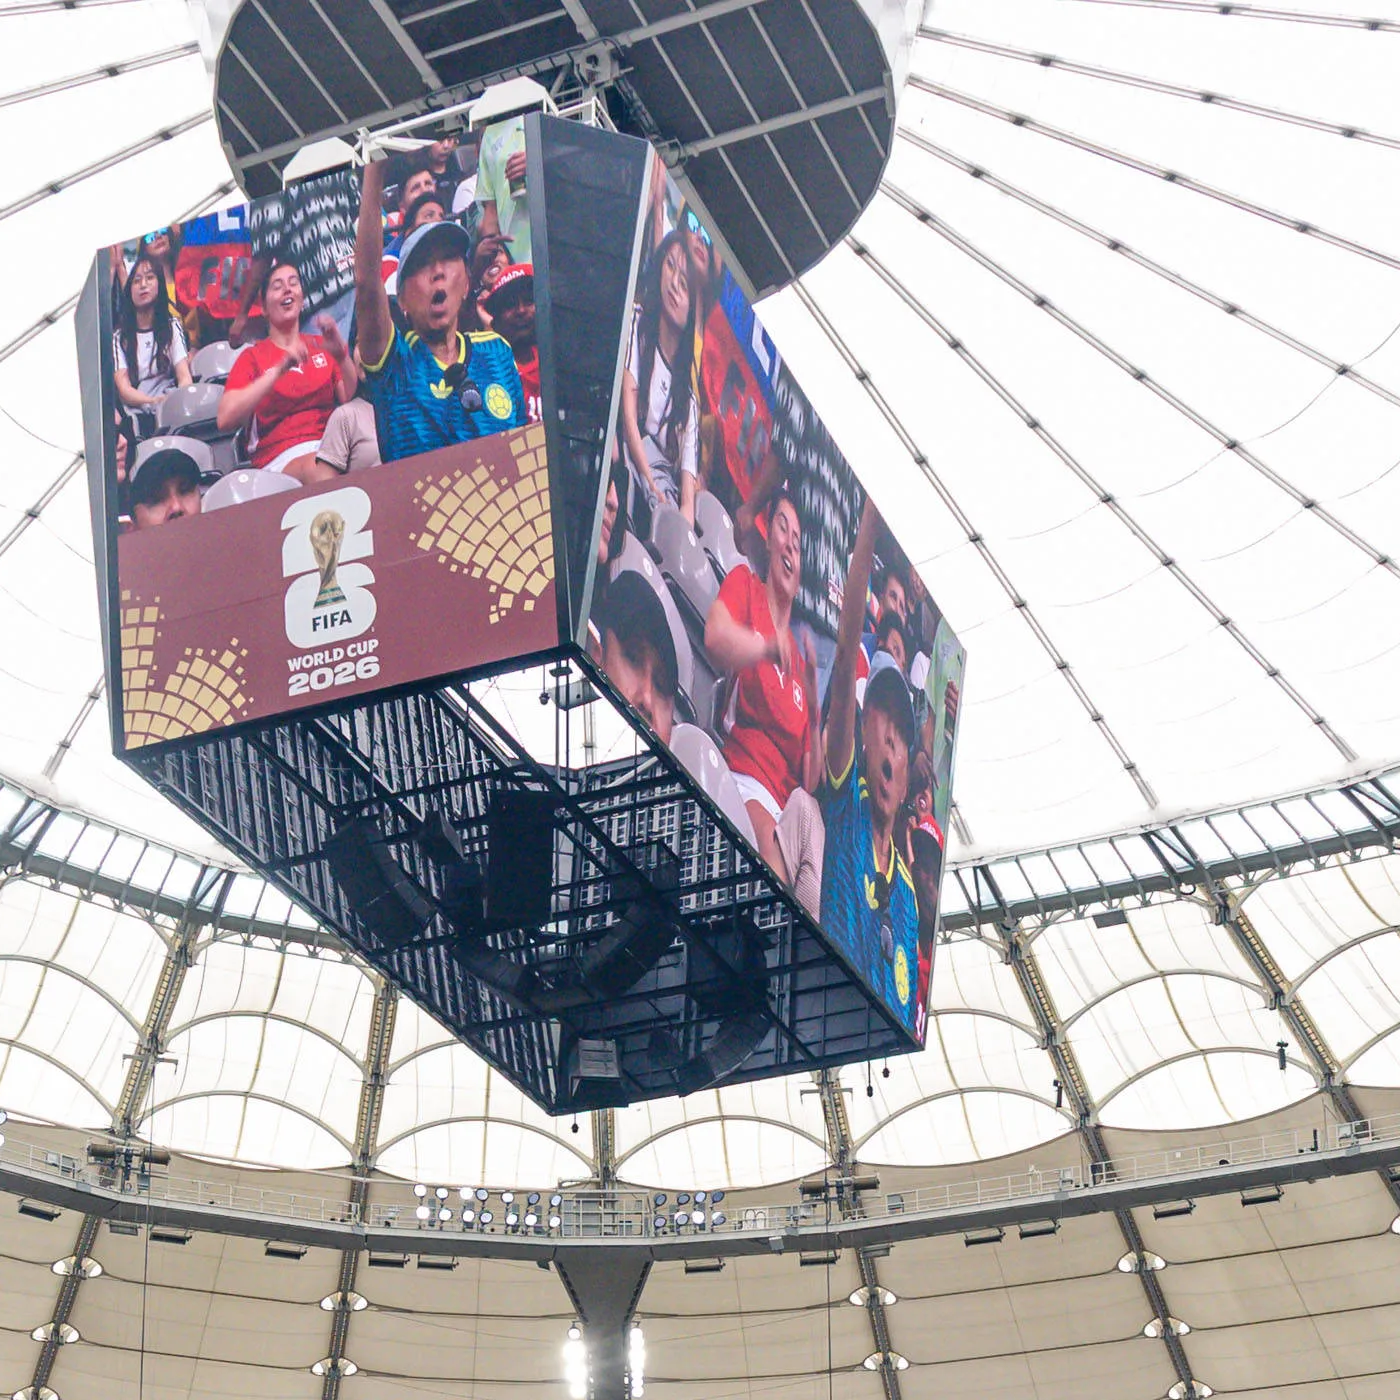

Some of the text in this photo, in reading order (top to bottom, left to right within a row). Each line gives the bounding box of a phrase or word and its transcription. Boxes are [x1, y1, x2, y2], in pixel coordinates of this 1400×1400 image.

[311, 609, 353, 632] FIFA
[287, 638, 379, 672] WORLD CUP
[288, 656, 381, 697] 2026
